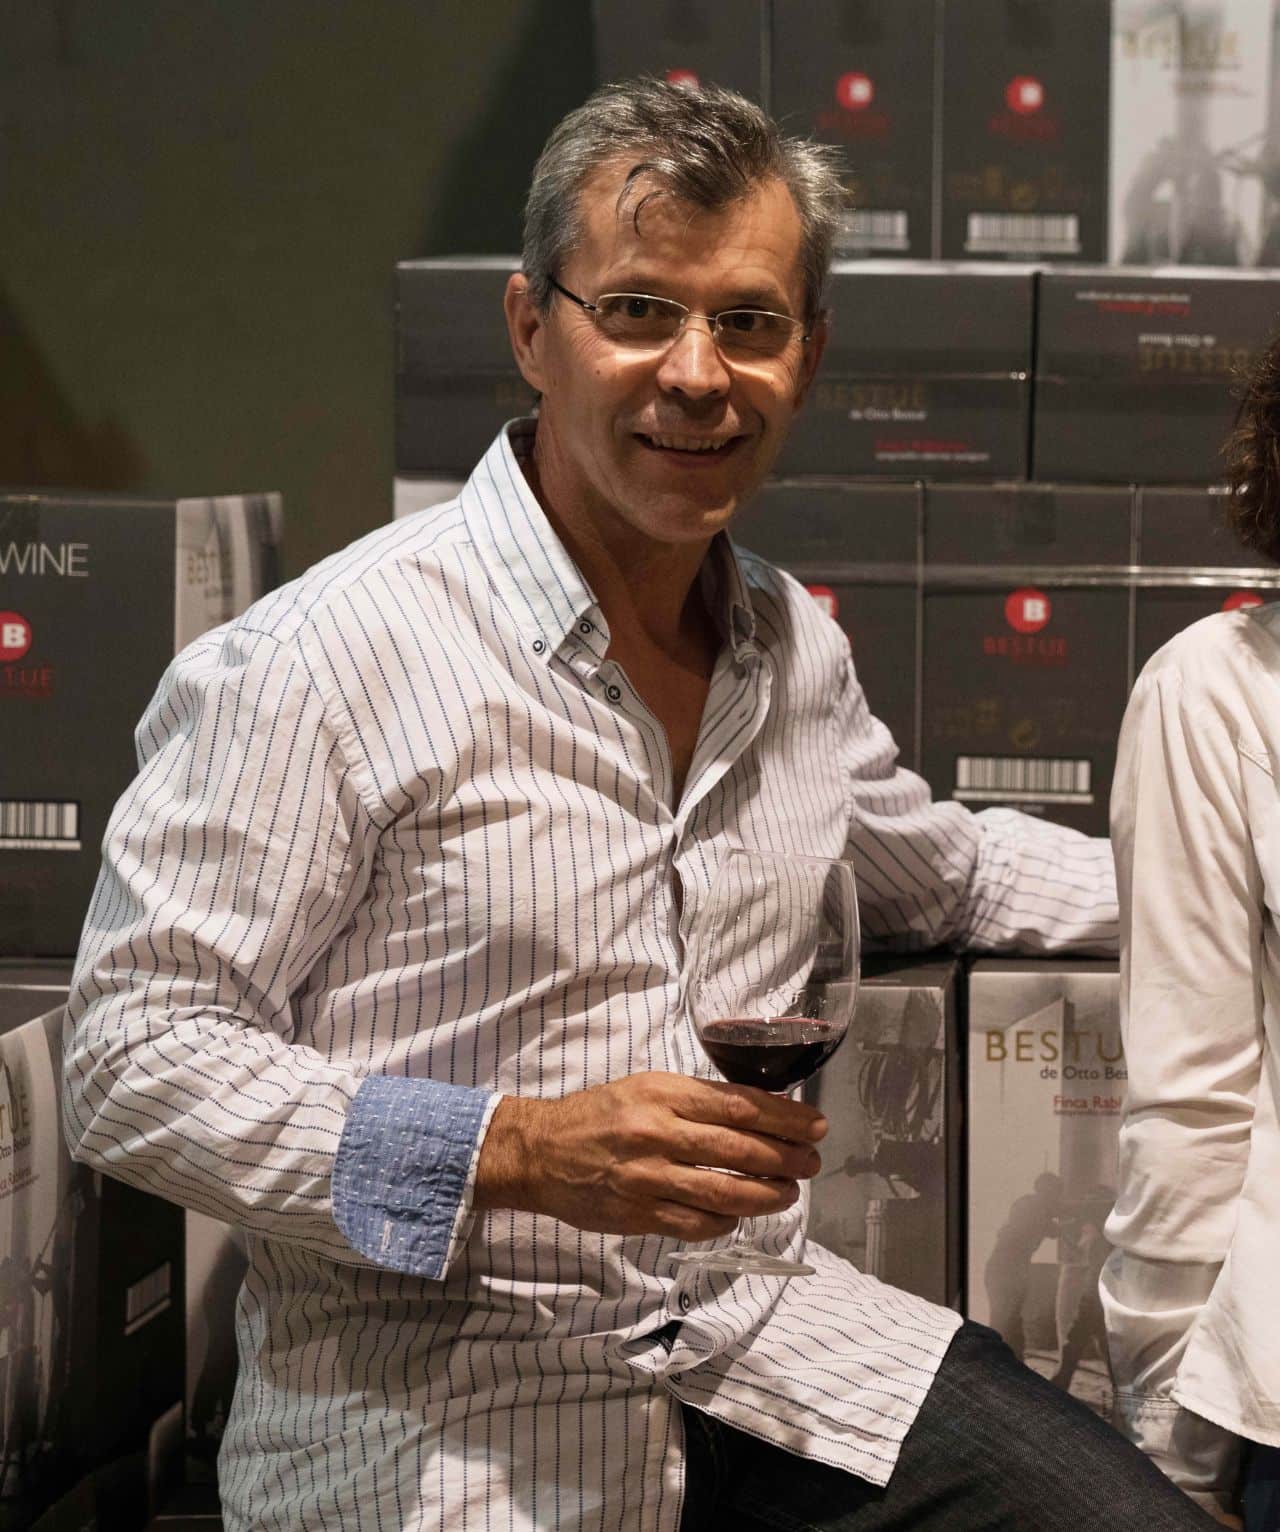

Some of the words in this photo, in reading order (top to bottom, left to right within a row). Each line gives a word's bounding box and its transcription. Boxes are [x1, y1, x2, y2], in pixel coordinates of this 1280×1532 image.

[0, 543, 89, 577] WINE
[1024, 598, 1046, 621] B
[3, 624, 26, 648] B
[986, 1029, 1124, 1062] BESTU
[1040, 1066, 1057, 1079] de
[1063, 1065, 1098, 1080] Otto
[1105, 1066, 1128, 1080] Bes
[1093, 1096, 1122, 1109] Rabl
